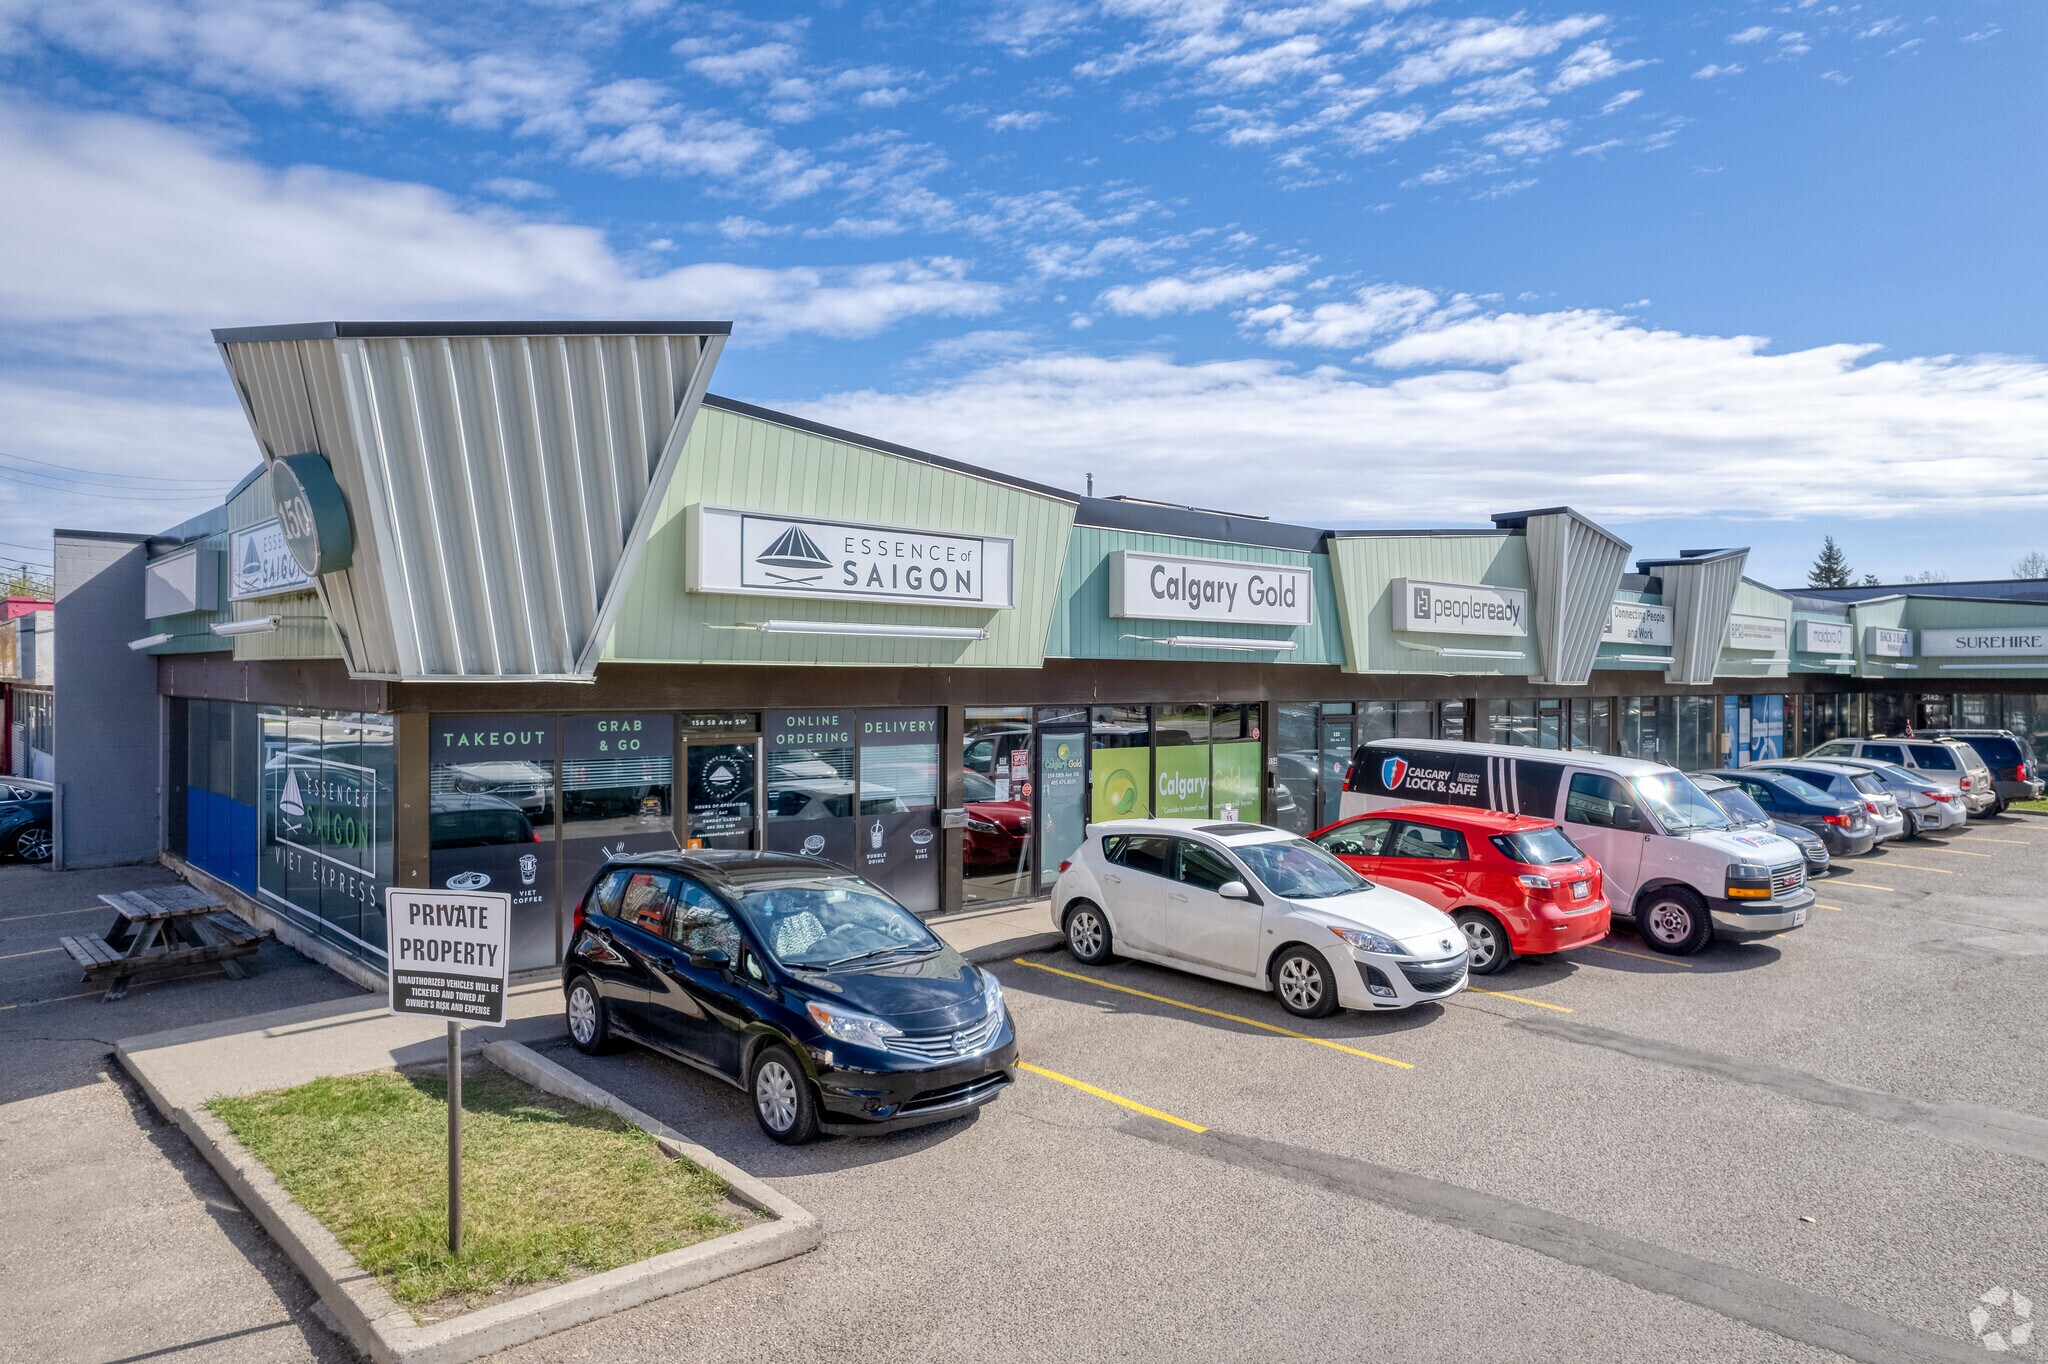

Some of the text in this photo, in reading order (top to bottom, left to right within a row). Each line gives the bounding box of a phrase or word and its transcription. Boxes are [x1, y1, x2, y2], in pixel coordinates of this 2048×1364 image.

[845, 536, 972, 564] ESSENCE of
[843, 560, 972, 594] SAIGON
[1150, 565, 1297, 612] Calgary Gold
[1434, 596, 1520, 627] peopleready
[1614, 605, 1665, 625] Connecting People
[1627, 626, 1654, 640] and Work
[1956, 635, 2042, 650] SUREHIRE
[597, 720, 643, 732] GRAB
[786, 715, 840, 727] ONLINE
[864, 720, 936, 734] DELIVERY
[443, 731, 545, 747] TAKEOUT
[599, 739, 641, 752] & GO
[776, 732, 849, 745] ORDERING
[1068, 758, 1082, 768] Gold
[1408, 767, 1451, 780] CALGARY
[307, 778, 360, 808] ESSENCE
[1159, 771, 1207, 800] Calgary
[1405, 777, 1478, 796] LOCK & SAFE
[306, 804, 369, 851] SAIGON
[1644, 834, 1651, 843] 6
[275, 846, 376, 907] VIET EXPRESS
[513, 895, 543, 905] COFFEE
[409, 902, 488, 930] PRIVATE
[399, 937, 498, 967] PROPERTY
[397, 975, 500, 993] UNAUTHORIZED VEHICLES WILL BE
[411, 987, 486, 1003] TICKETED AND TOWED AT
[405, 998, 491, 1016] OWNER'S RISK AND EXPENSE
